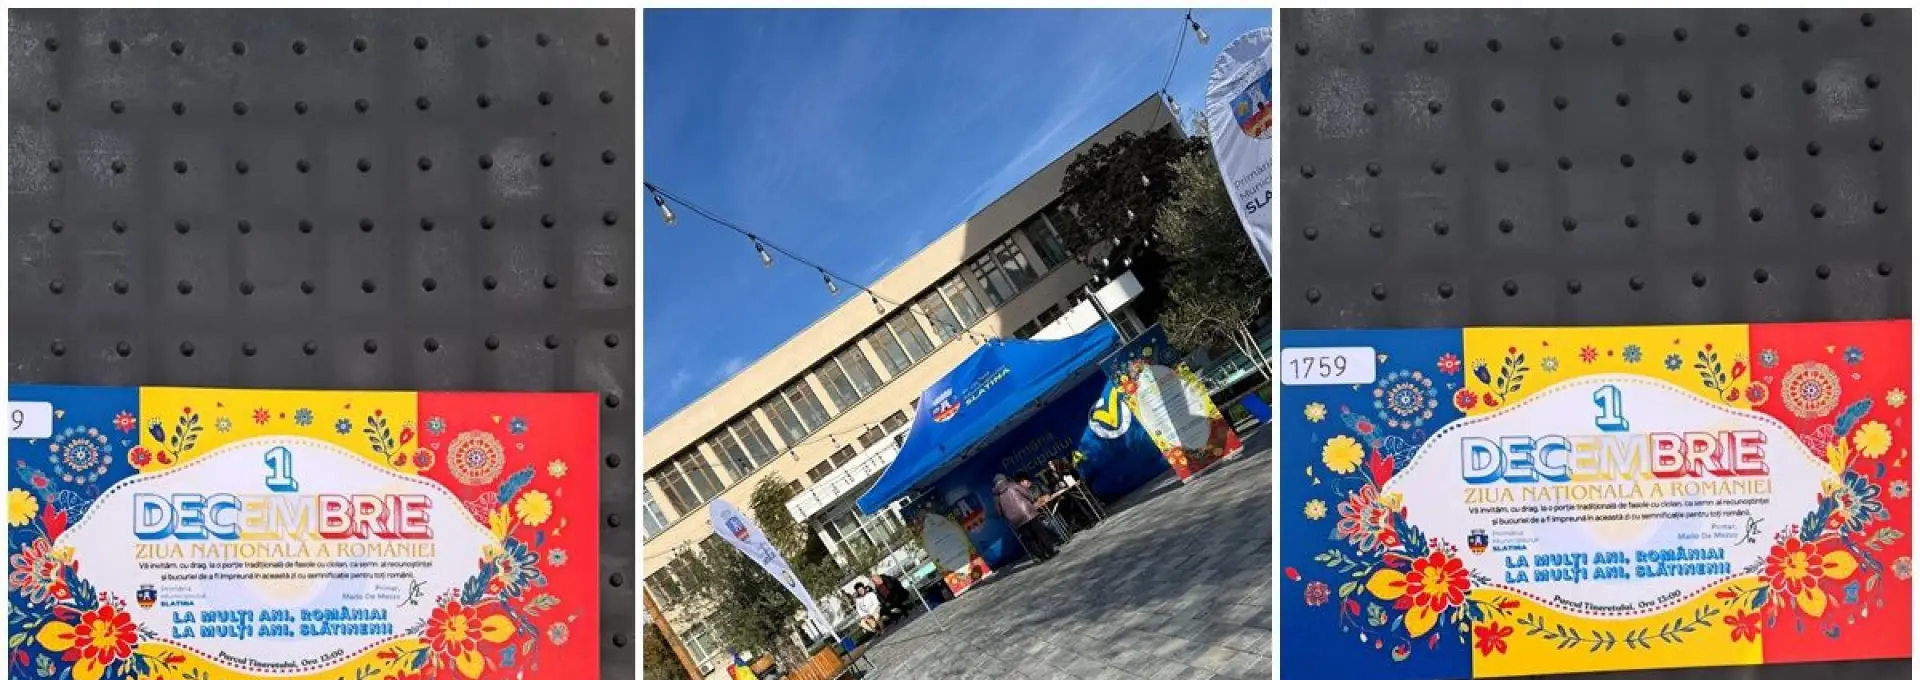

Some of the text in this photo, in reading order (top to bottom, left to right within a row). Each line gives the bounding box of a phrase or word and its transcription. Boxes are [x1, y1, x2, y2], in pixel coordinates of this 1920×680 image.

[1233, 158, 1272, 190] Primări
[1289, 355, 1348, 379] 1759
[1593, 384, 1629, 432] 1
[1461, 430, 1770, 484] DECEMBRIE
[264, 446, 299, 492] 1
[1464, 486, 1515, 504] ZIUA
[1650, 482, 1664, 497] A
[1671, 478, 1772, 497] ROMÂNIEI
[133, 493, 435, 540] DECEMBRIE
[136, 543, 184, 559] ZIUA
[317, 543, 331, 558] A
[337, 540, 435, 558] ROMÂNIEI
[1505, 555, 1529, 569] LA
[1593, 550, 1630, 566] ANI,
[1505, 569, 1529, 584] LA
[1593, 565, 1630, 580] ANI,
[172, 611, 196, 623] LA
[259, 608, 295, 622] ANI,
[1637, 601, 1655, 609] Ora
[172, 625, 196, 638] LA
[258, 623, 295, 637] ANI,
[301, 659, 318, 667] Ora
